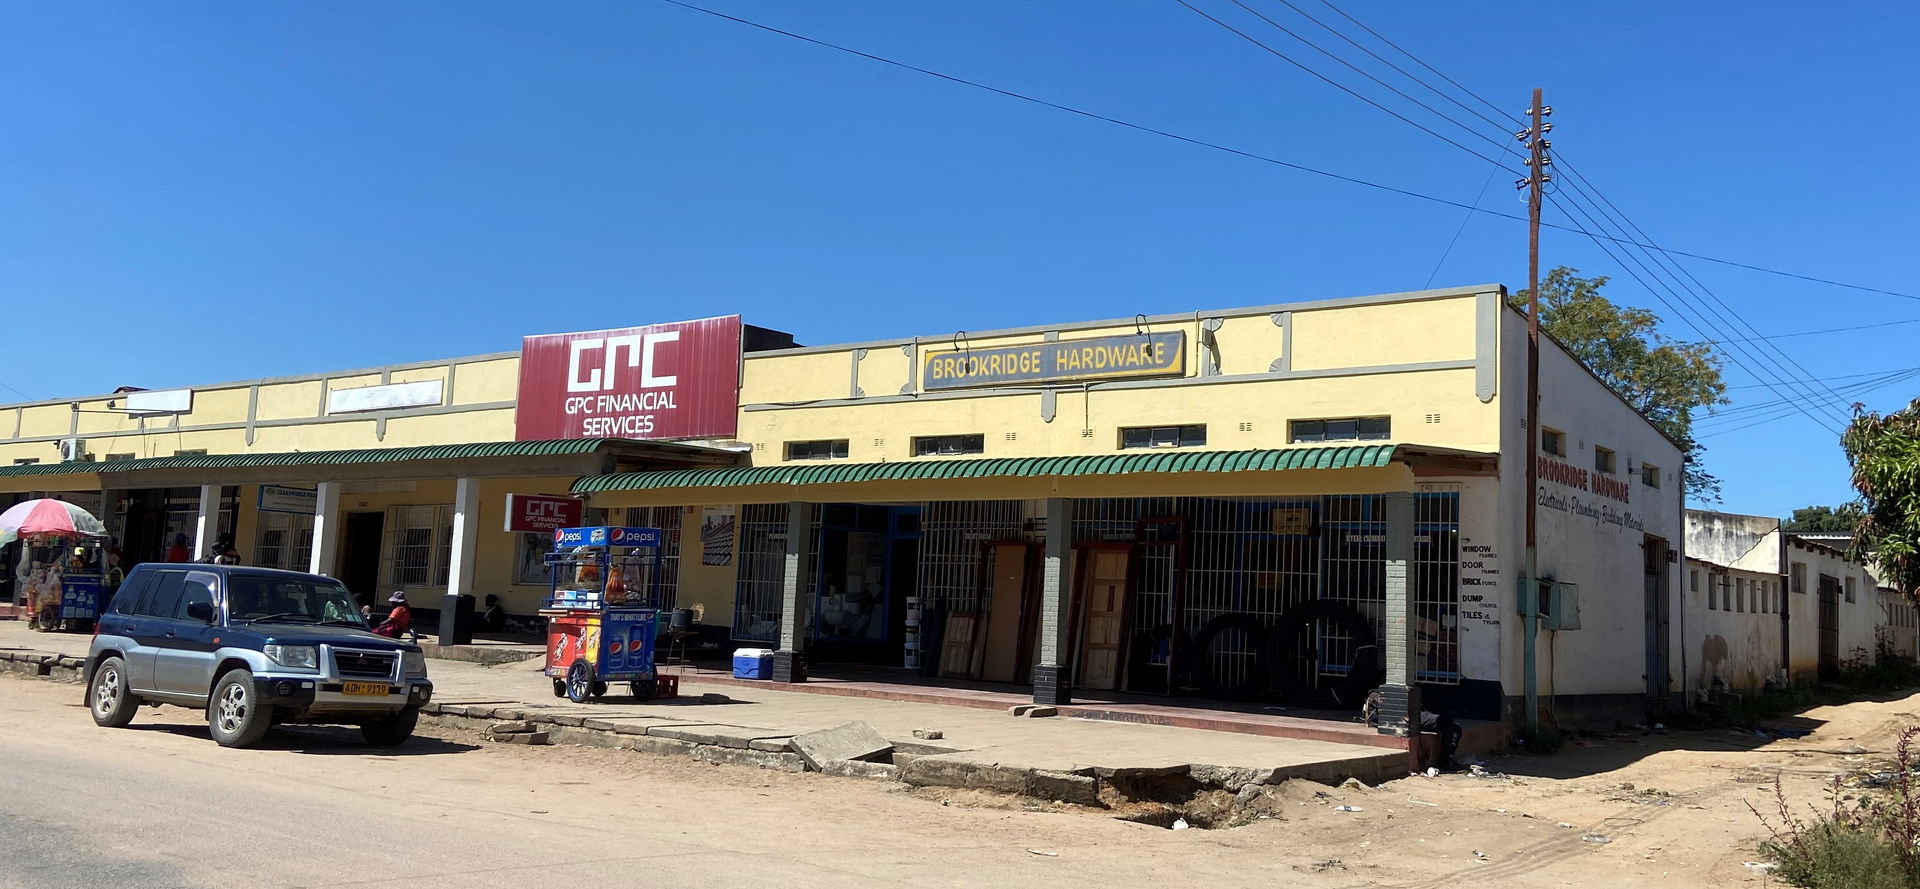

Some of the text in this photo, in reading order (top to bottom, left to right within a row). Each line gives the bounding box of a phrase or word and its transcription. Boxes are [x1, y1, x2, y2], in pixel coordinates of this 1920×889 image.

[933, 342, 1164, 380] BROOKRIDGE HARDWARE
[565, 391, 677, 415] GPC FINANCIAL
[583, 415, 654, 436] SERVICES
[1537, 456, 1630, 504] BROOKRIDGE HARDWARE
[1571, 496, 1600, 526] Plumbing
[564, 531, 582, 543] pepsi
[626, 531, 655, 543] pepsi
[1462, 545, 1491, 553] WINDOW
[1462, 611, 1482, 619] TILES
